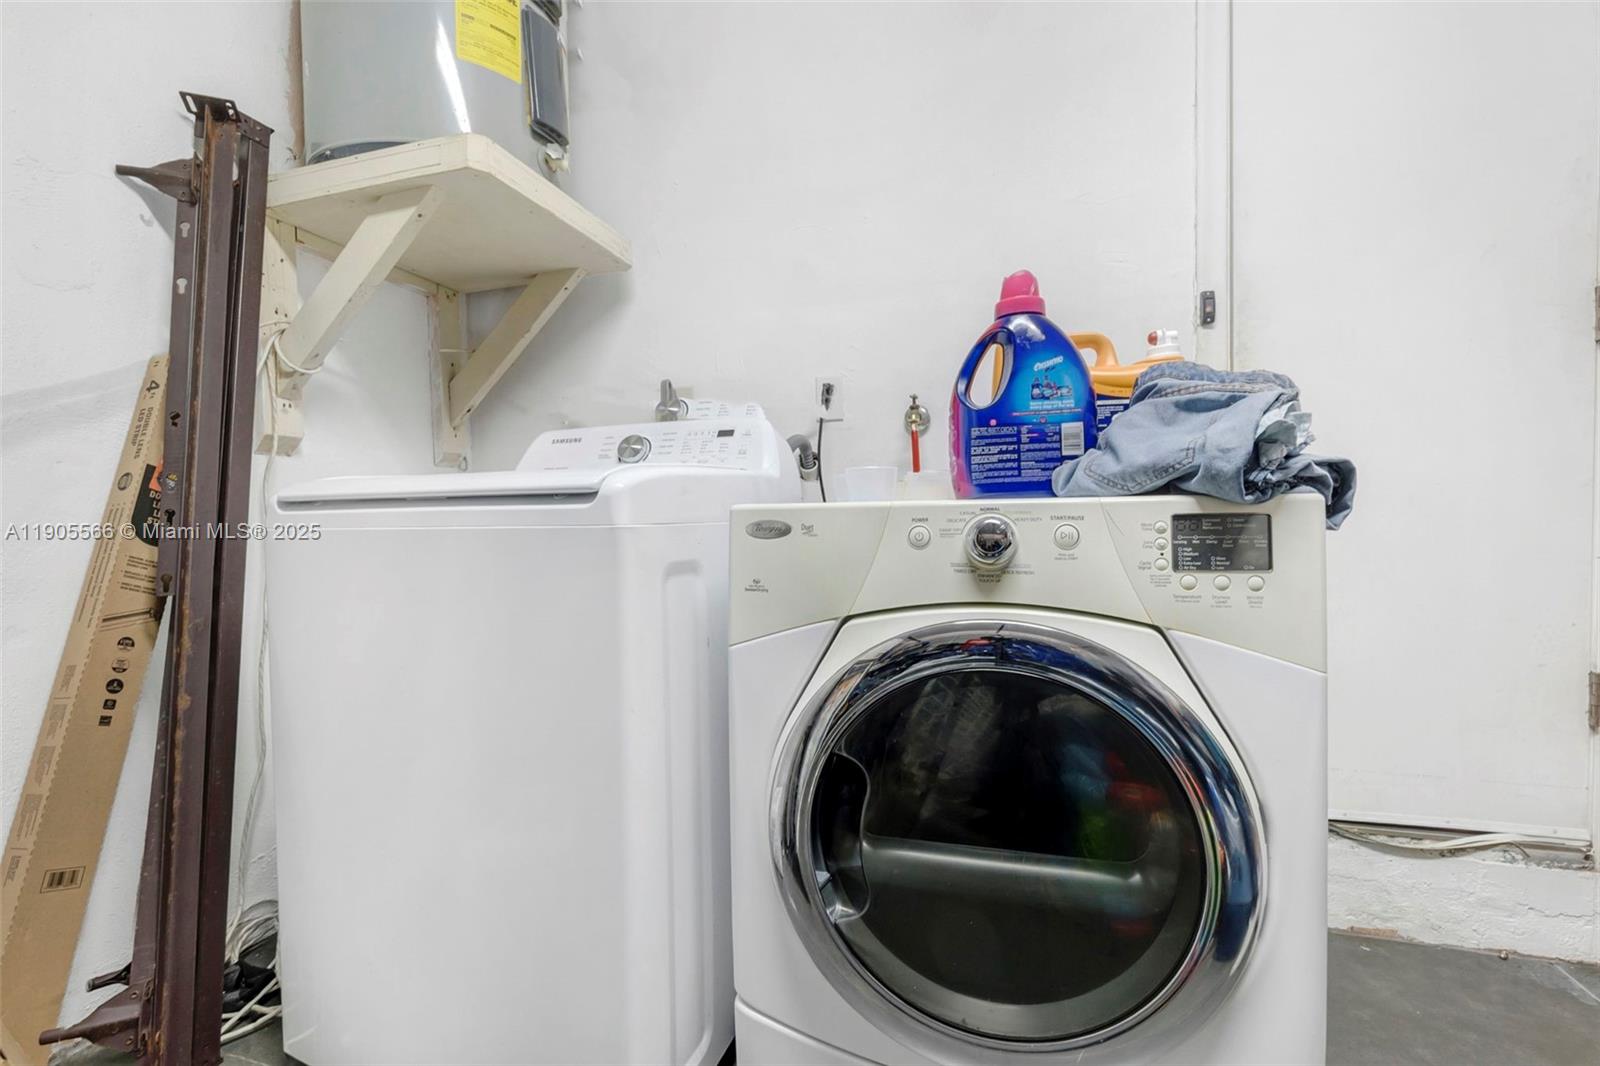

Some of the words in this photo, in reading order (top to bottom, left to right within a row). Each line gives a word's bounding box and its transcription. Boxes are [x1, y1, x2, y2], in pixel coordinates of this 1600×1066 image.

[146, 380, 160, 393] 4
[137, 408, 147, 423] LED
[139, 406, 154, 437] DOUBLE
[130, 424, 142, 447] STRIP
[551, 437, 583, 445] SAMSUNG
[133, 439, 145, 459] LENS
